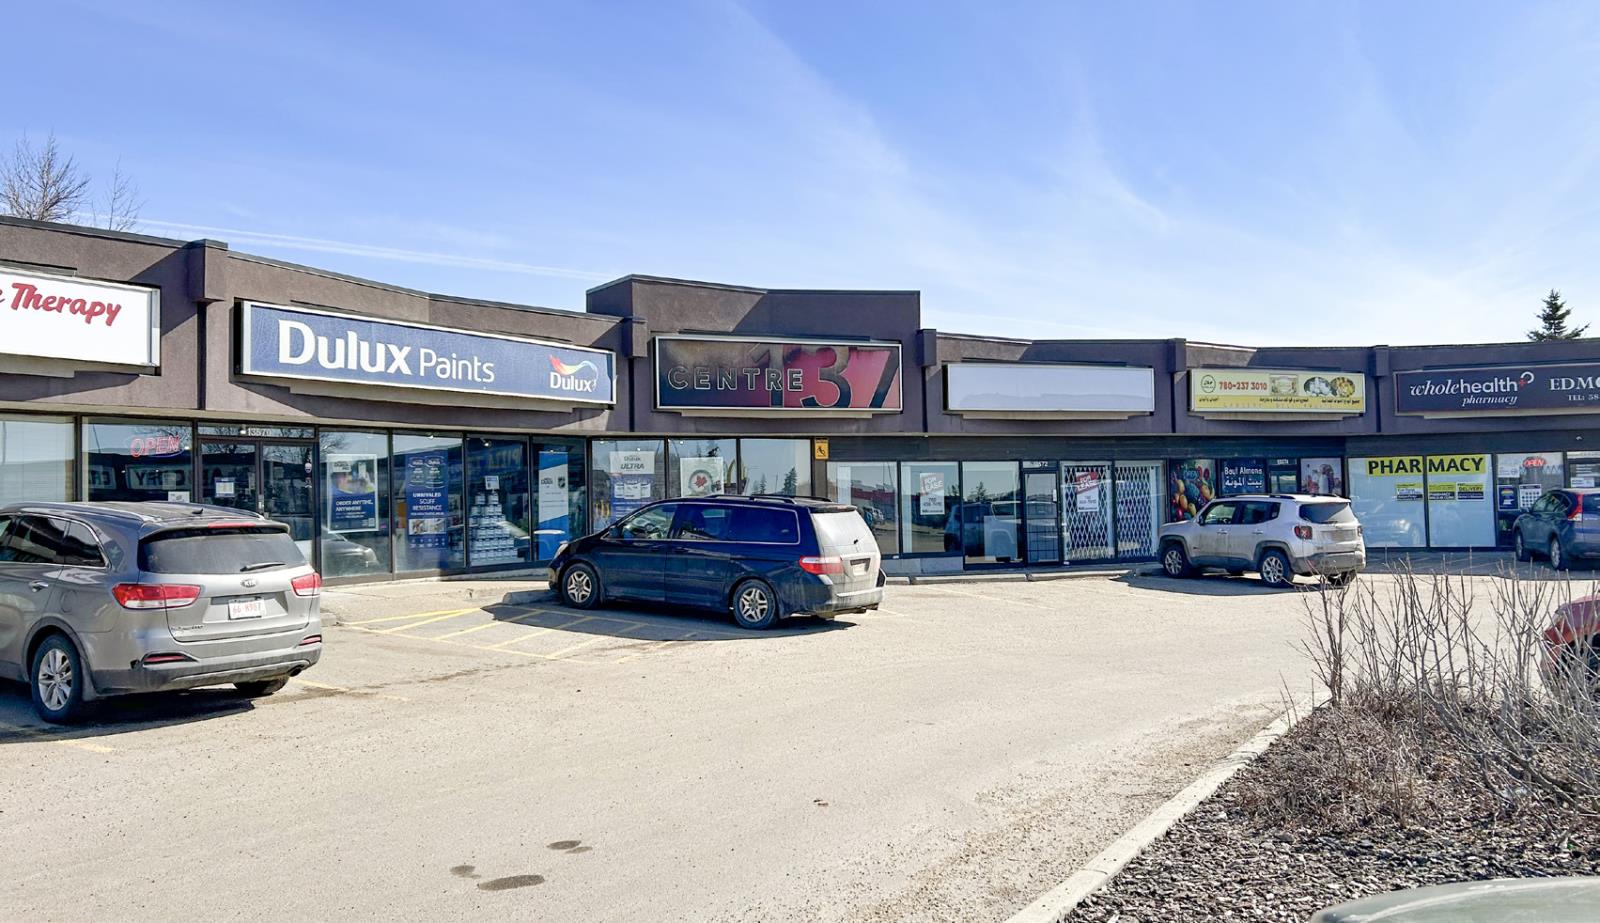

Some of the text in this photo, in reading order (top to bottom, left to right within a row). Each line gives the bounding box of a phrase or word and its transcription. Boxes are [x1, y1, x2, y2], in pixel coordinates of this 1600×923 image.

[12, 282, 121, 327] Therapy
[278, 319, 495, 383] Dulux Paints
[549, 371, 593, 392] Dulux
[667, 366, 804, 392] CENTRE
[747, 343, 900, 408] 137
[1219, 381, 1249, 390] 780-237
[1251, 382, 1267, 391] 3010
[1462, 395, 1517, 407] pharmacy
[130, 436, 181, 457] OPEN
[1523, 459, 1544, 467] OPEN
